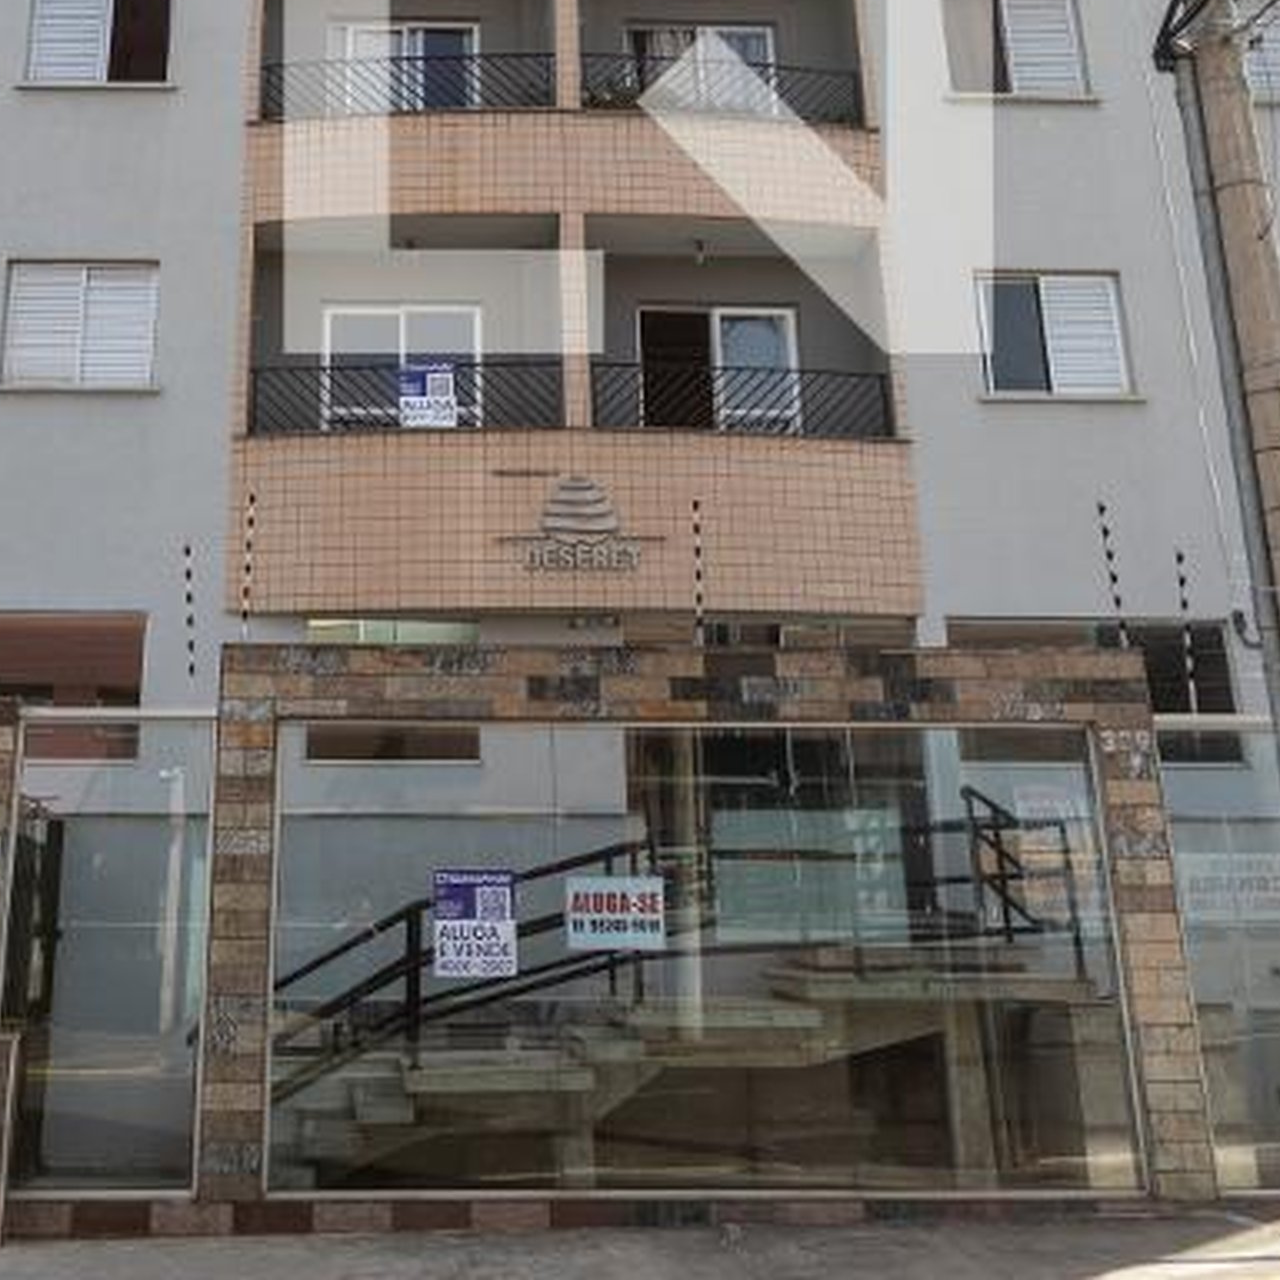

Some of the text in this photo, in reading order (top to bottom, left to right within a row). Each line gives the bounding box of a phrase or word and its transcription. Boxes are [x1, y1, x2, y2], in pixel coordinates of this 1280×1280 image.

[571, 891, 660, 913] ALUGA-SE
[439, 924, 500, 941] ALUGA
[452, 942, 512, 958] VENDE
